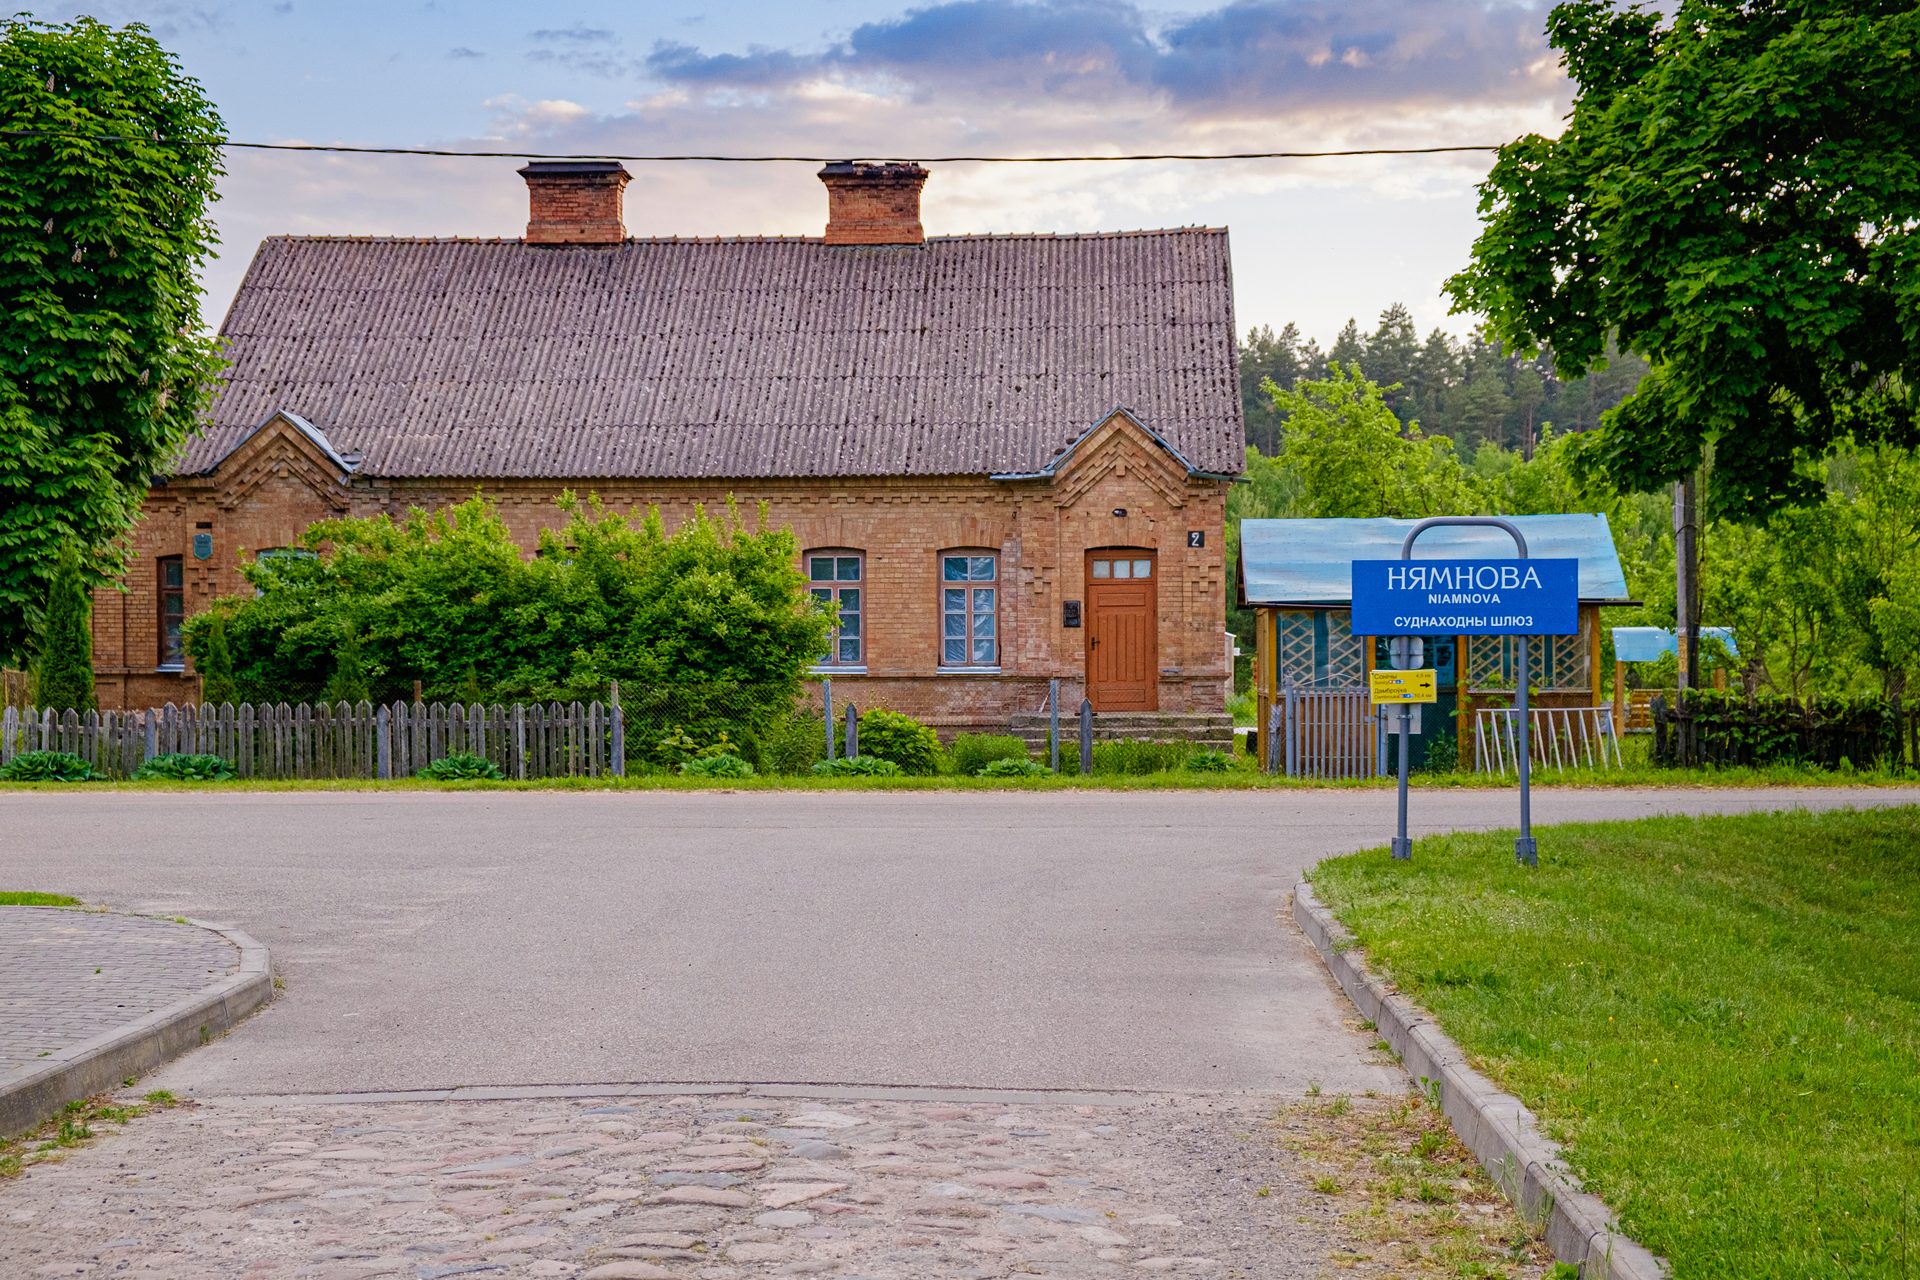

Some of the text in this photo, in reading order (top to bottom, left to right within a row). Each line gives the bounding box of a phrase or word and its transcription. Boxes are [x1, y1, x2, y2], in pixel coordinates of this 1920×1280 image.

[1191, 532, 1200, 547] 2
[1387, 566, 1543, 590] НЯМНОВА
[1428, 593, 1501, 604] NIAMNOVA
[1394, 615, 1533, 629] СУДНАХОДНЫ ШЛЮЗ
